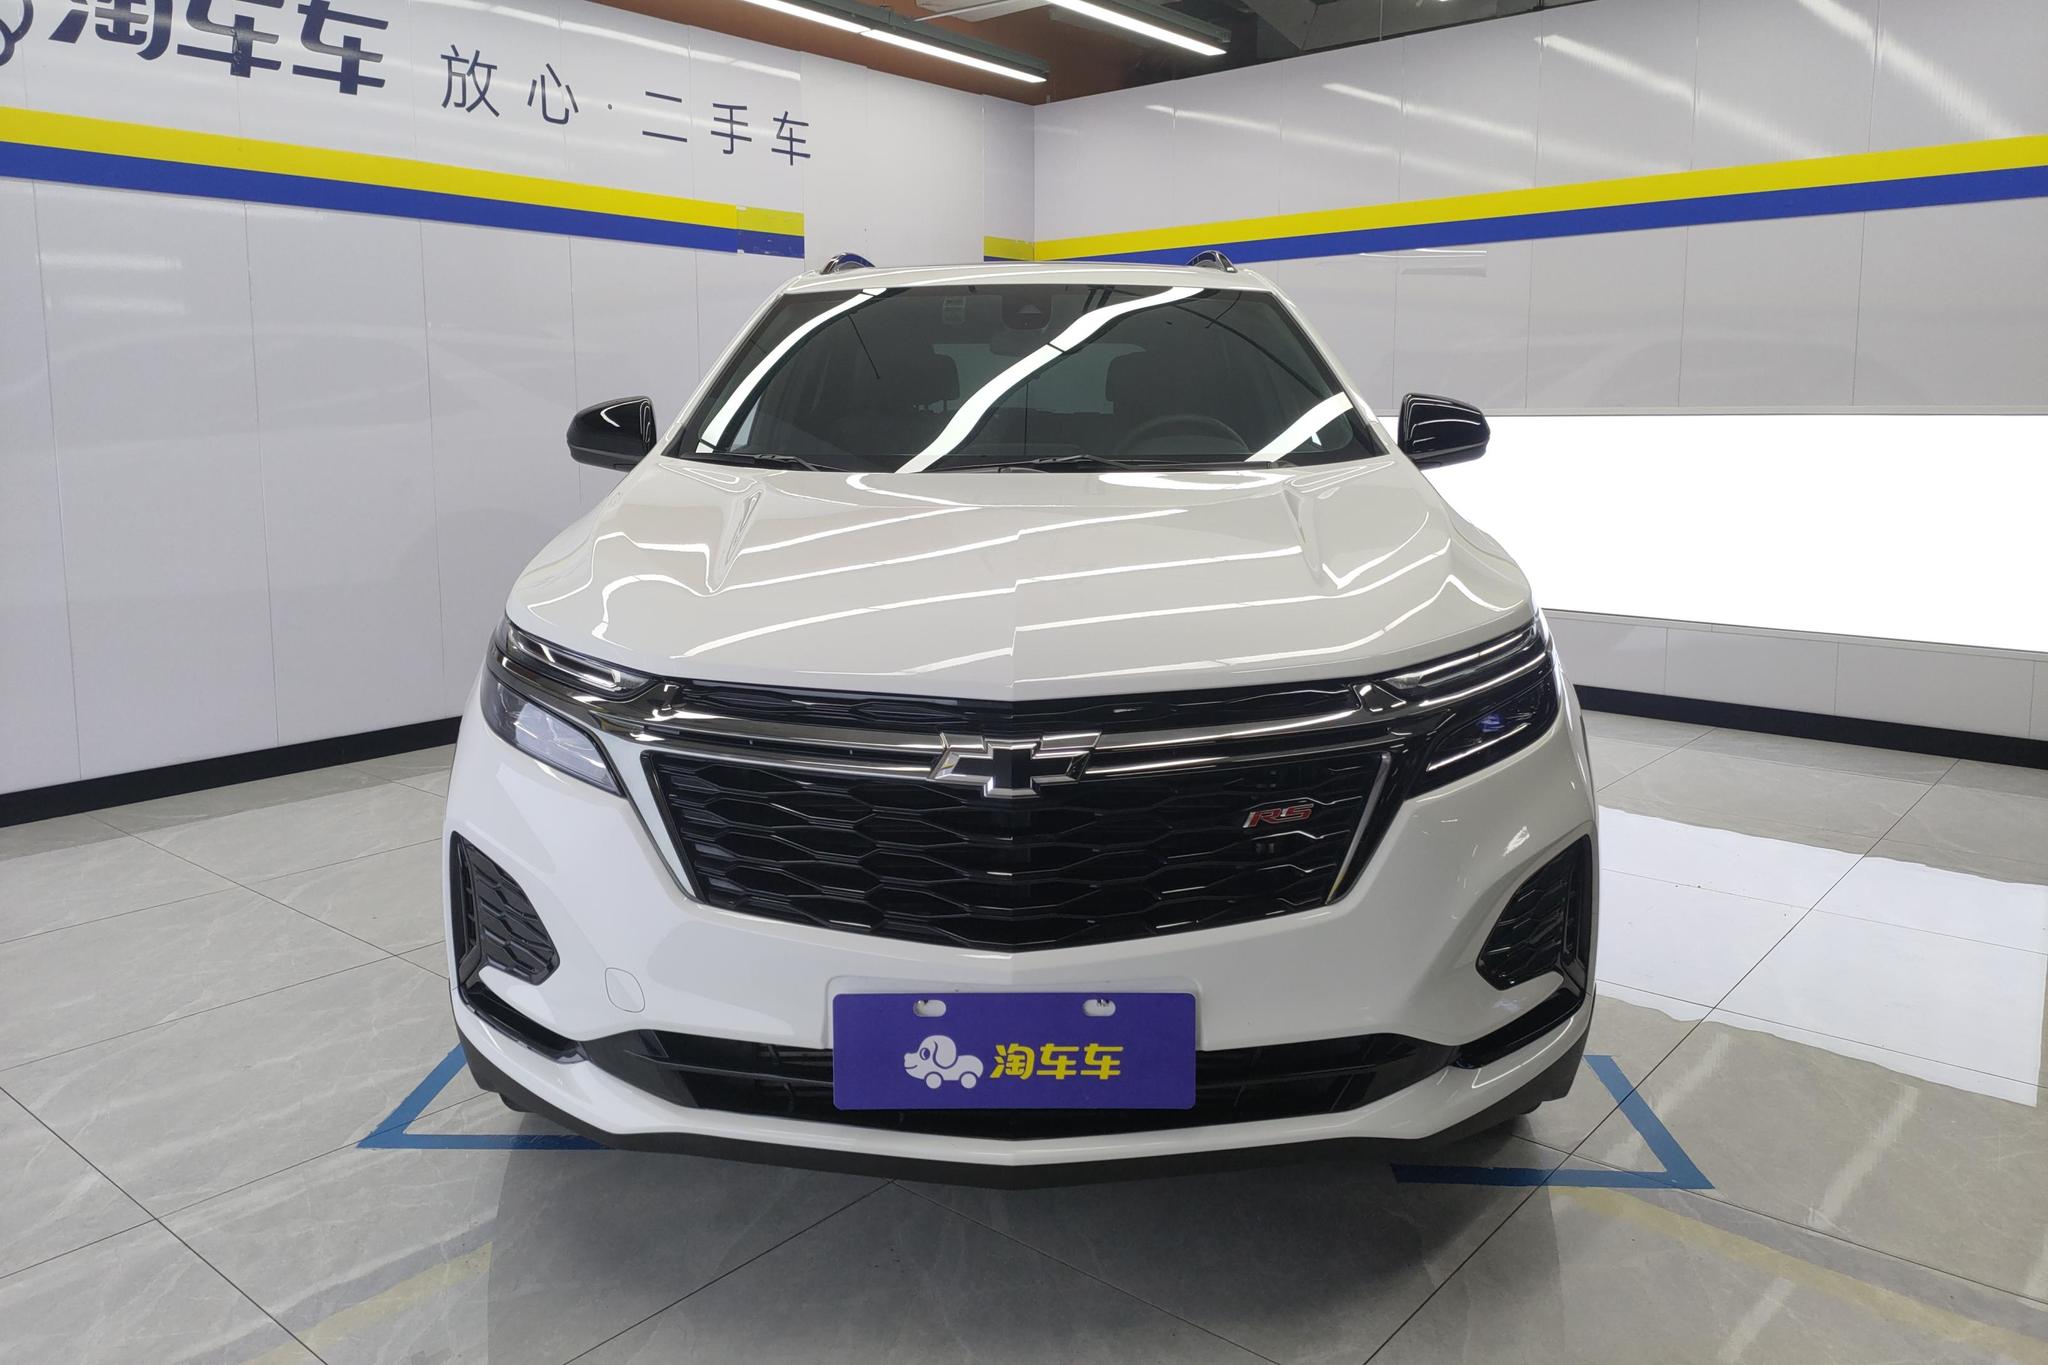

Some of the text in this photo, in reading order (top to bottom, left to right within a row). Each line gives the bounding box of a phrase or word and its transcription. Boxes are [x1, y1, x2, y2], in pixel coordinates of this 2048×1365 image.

[1242, 803, 1315, 828] RS
[990, 1043, 1124, 1080] 淘车车
